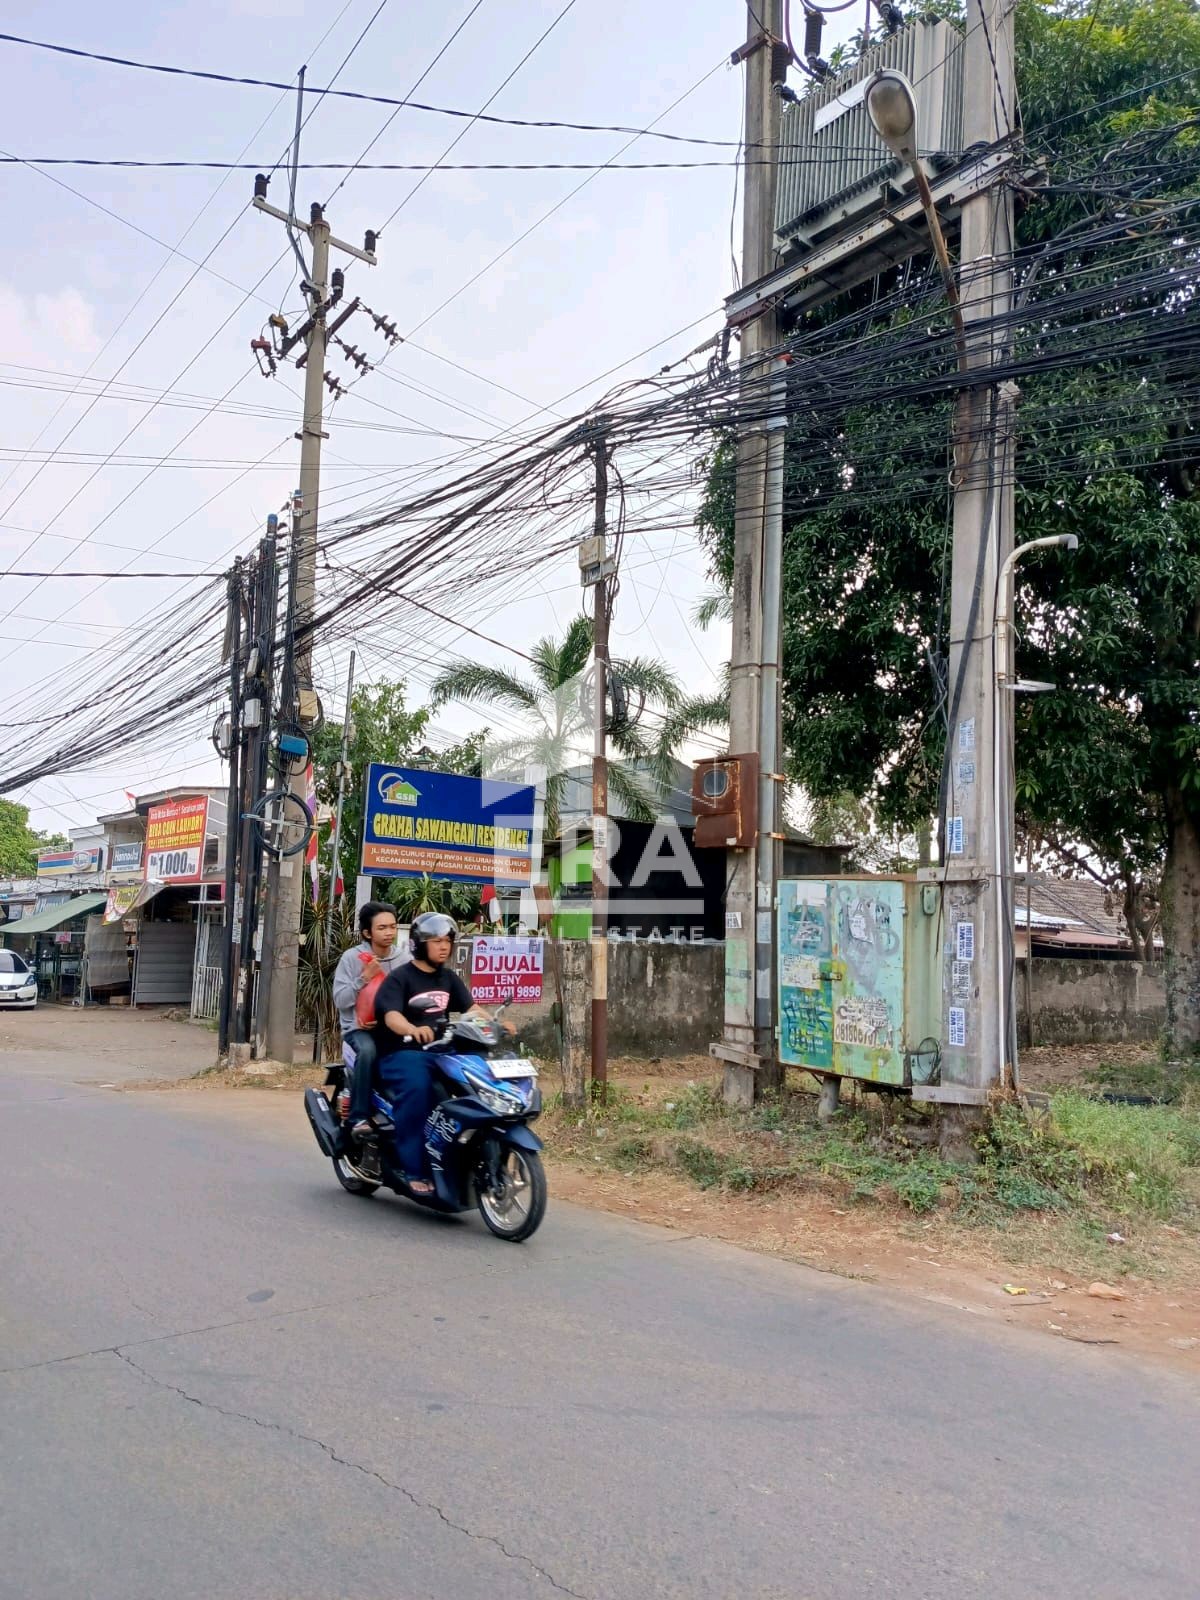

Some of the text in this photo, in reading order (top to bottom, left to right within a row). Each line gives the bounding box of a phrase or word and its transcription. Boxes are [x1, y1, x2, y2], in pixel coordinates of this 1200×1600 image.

[373, 813, 529, 852] GRAHA SAWANGAN RESIDENCE
[375, 856, 420, 865] KECAMATAN
[463, 863, 482, 871] KOTA
[380, 848, 399, 856] RAYA
[400, 850, 426, 858] CURUG
[504, 859, 527, 868] CURUG
[475, 955, 540, 972] DIJUAL
[494, 975, 522, 985] LENY
[471, 986, 495, 998] 0813
[516, 985, 541, 998] 9898
